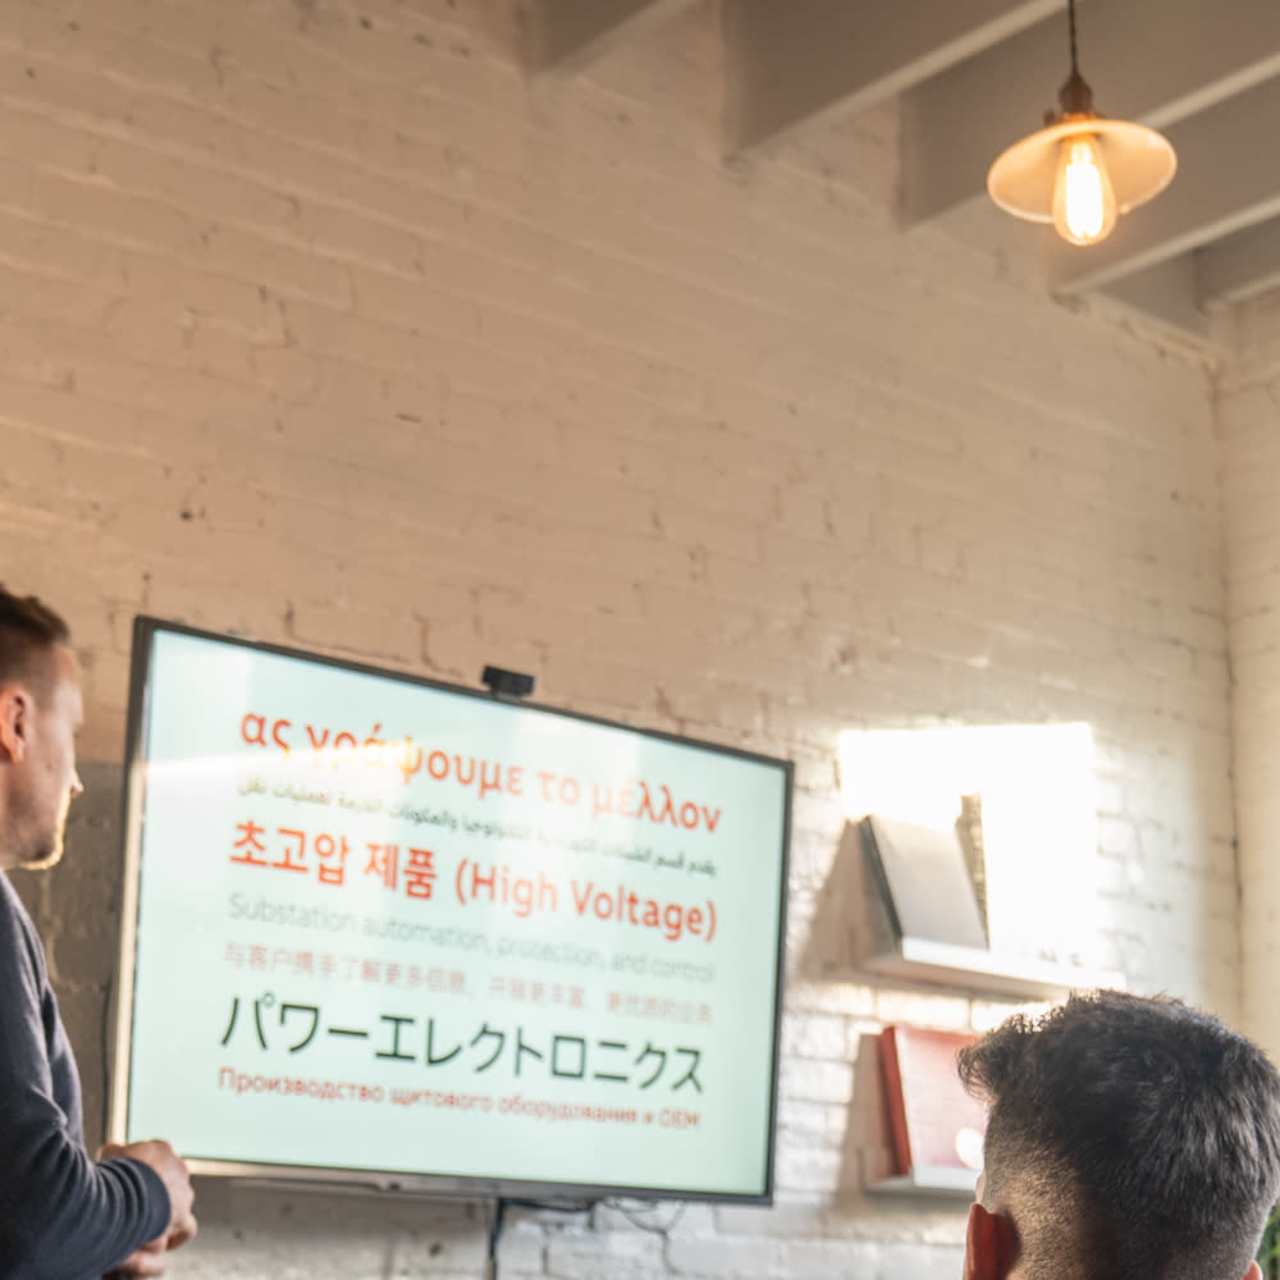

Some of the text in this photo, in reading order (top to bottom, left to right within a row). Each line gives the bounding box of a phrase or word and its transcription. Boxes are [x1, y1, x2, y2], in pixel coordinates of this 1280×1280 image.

[239, 711, 291, 759] ας
[230, 818, 718, 944] 초고압 제품 (High Voltage)
[228, 890, 355, 936] Substation
[221, 990, 703, 1094] パワーエレクトロニクス
[217, 1066, 385, 1108] Производство
